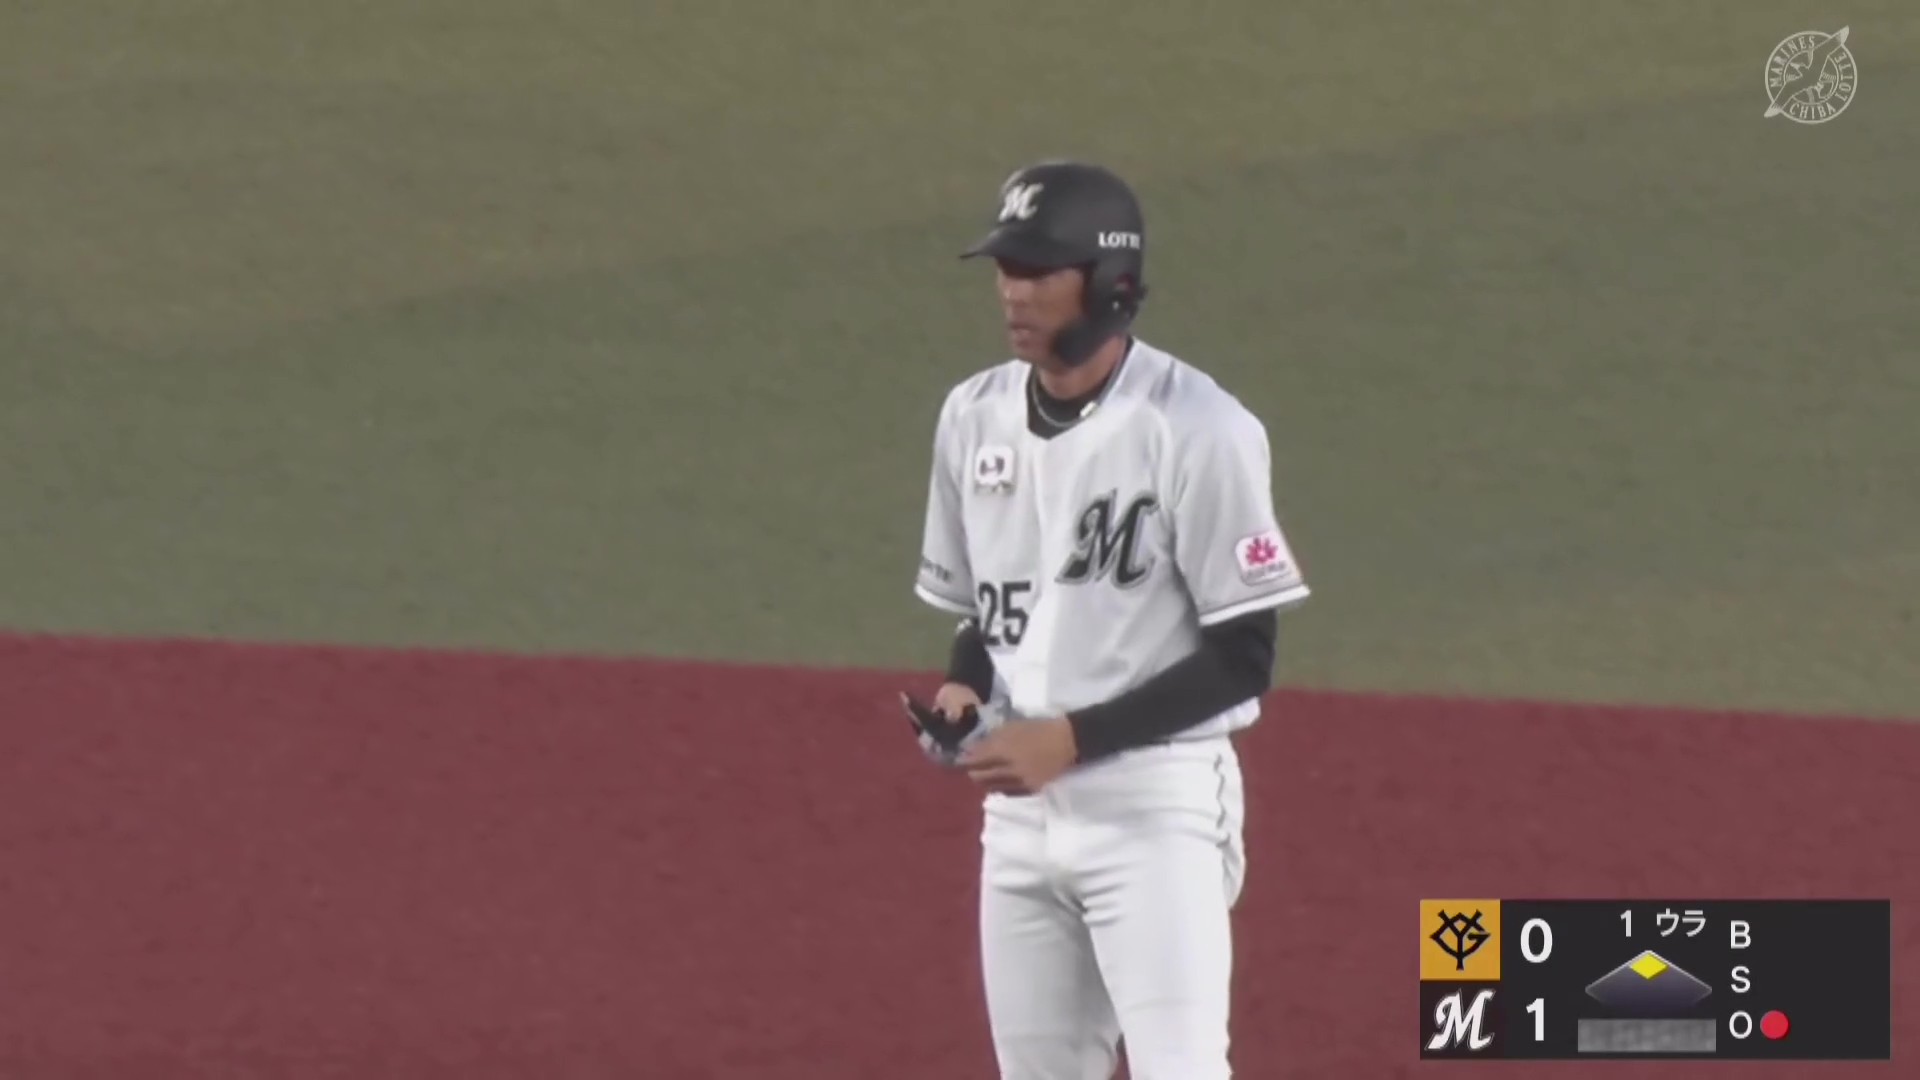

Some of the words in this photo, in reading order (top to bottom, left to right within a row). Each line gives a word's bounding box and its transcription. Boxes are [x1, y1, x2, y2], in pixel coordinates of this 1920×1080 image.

[998, 182, 1044, 222] M
[1055, 488, 1161, 588] M
[978, 580, 1031, 647] 25
